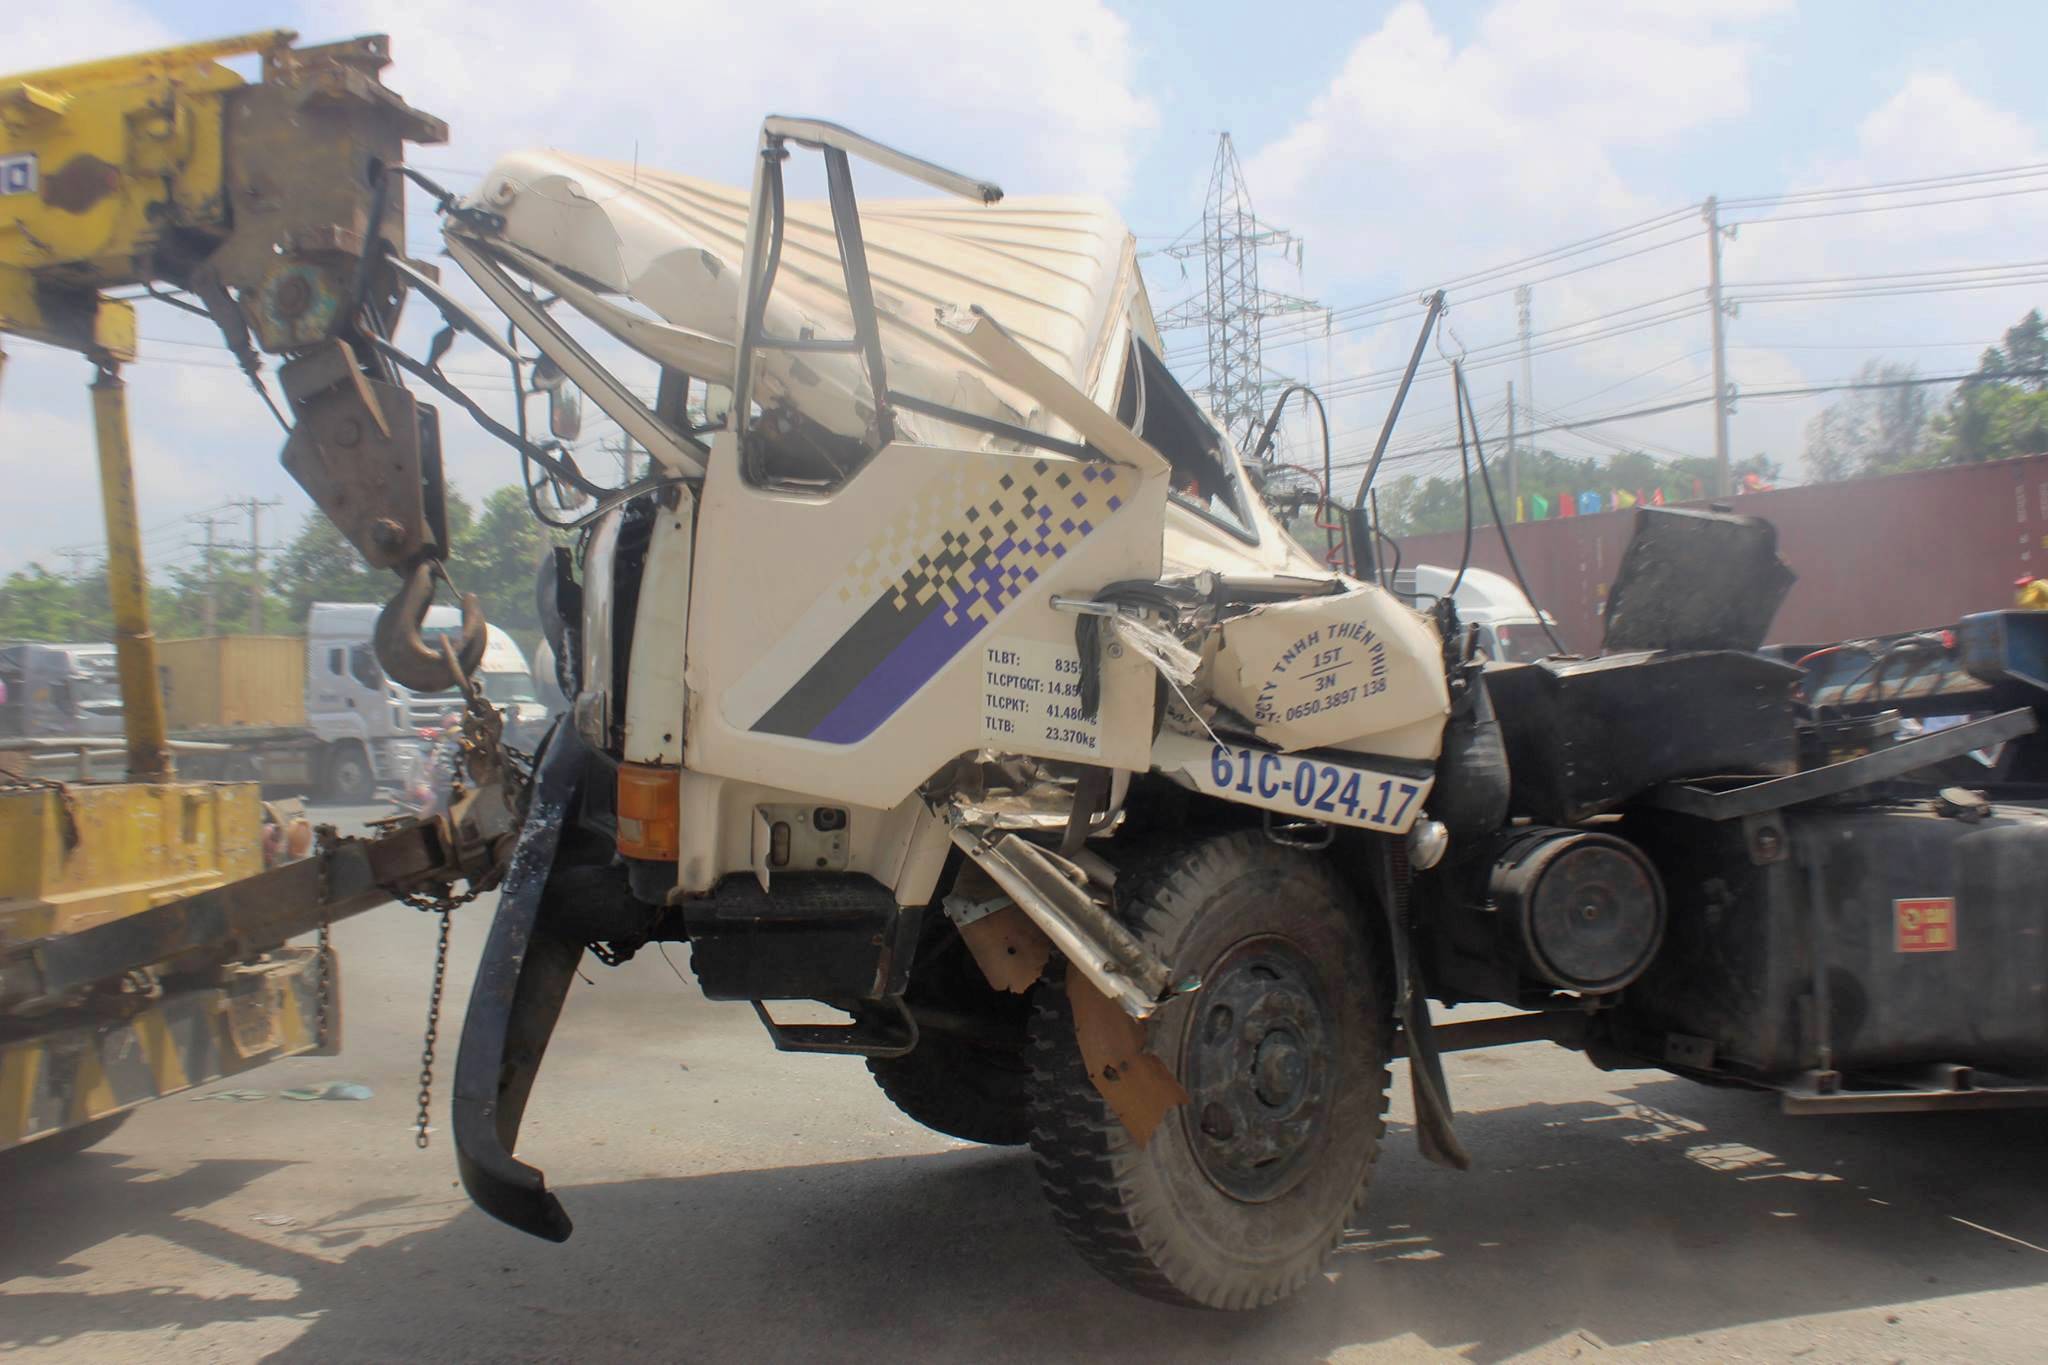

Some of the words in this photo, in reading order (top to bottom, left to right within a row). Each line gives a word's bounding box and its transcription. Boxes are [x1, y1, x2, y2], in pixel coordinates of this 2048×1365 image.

[986, 649, 1021, 667] TLBT:
[1055, 658, 1083, 675] 835
[1272, 630, 1320, 673] TNHH
[1312, 646, 1343, 669] 15T
[986, 671, 1044, 693] TLCPTGGT:
[1314, 673, 1337, 692] 3N
[985, 694, 1030, 713] TLCPKT:
[1285, 686, 1358, 722] 0650.3897
[1362, 677, 1387, 698] 138
[984, 715, 1015, 734] TLTB:
[1045, 726, 1097, 749] 23.370kg
[1211, 744, 1419, 827] 61C-024.17
